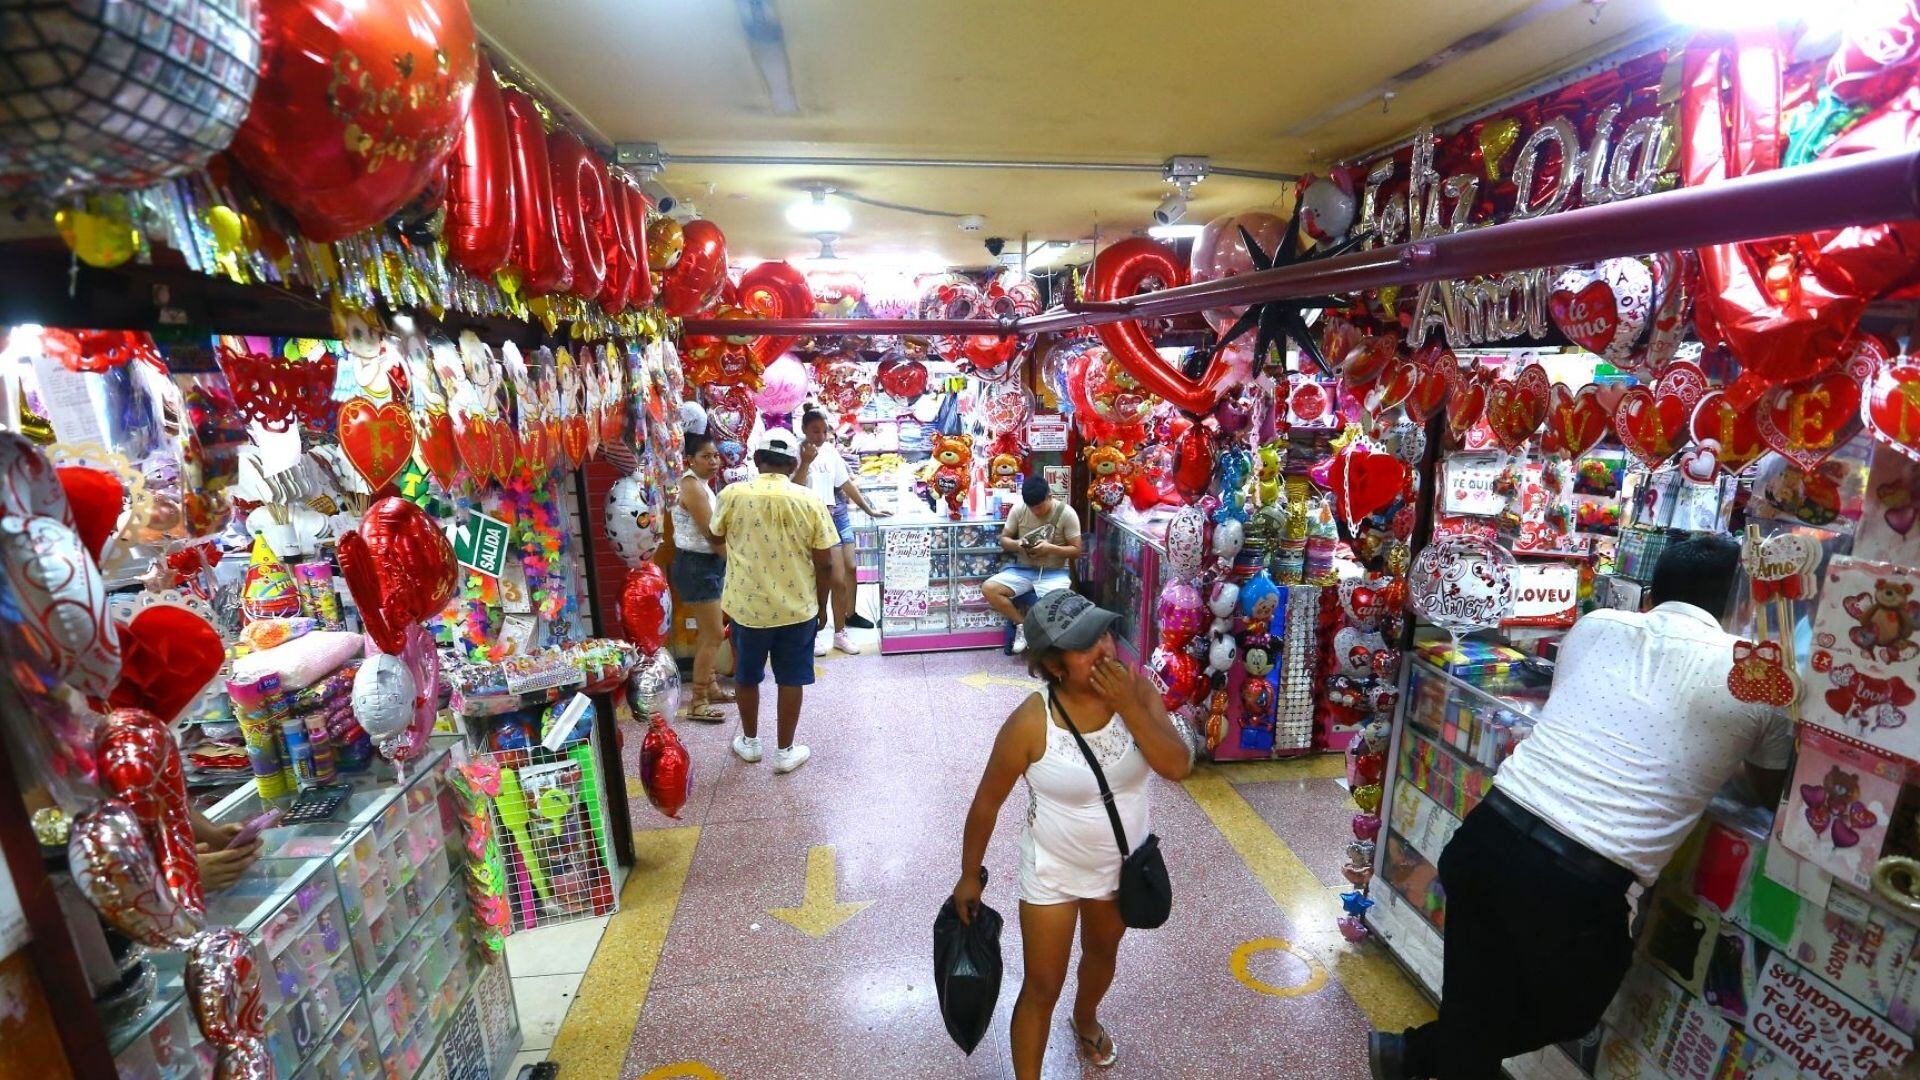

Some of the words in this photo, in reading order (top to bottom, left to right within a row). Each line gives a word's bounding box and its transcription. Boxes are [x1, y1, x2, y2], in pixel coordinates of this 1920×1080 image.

[1453, 478, 1465, 488] TE
[480, 528, 502, 571] SALIDA
[1756, 561, 1796, 578] Amo
[1762, 984, 1817, 1043] Feliz
[1672, 1010, 1705, 1078] SHOWER
